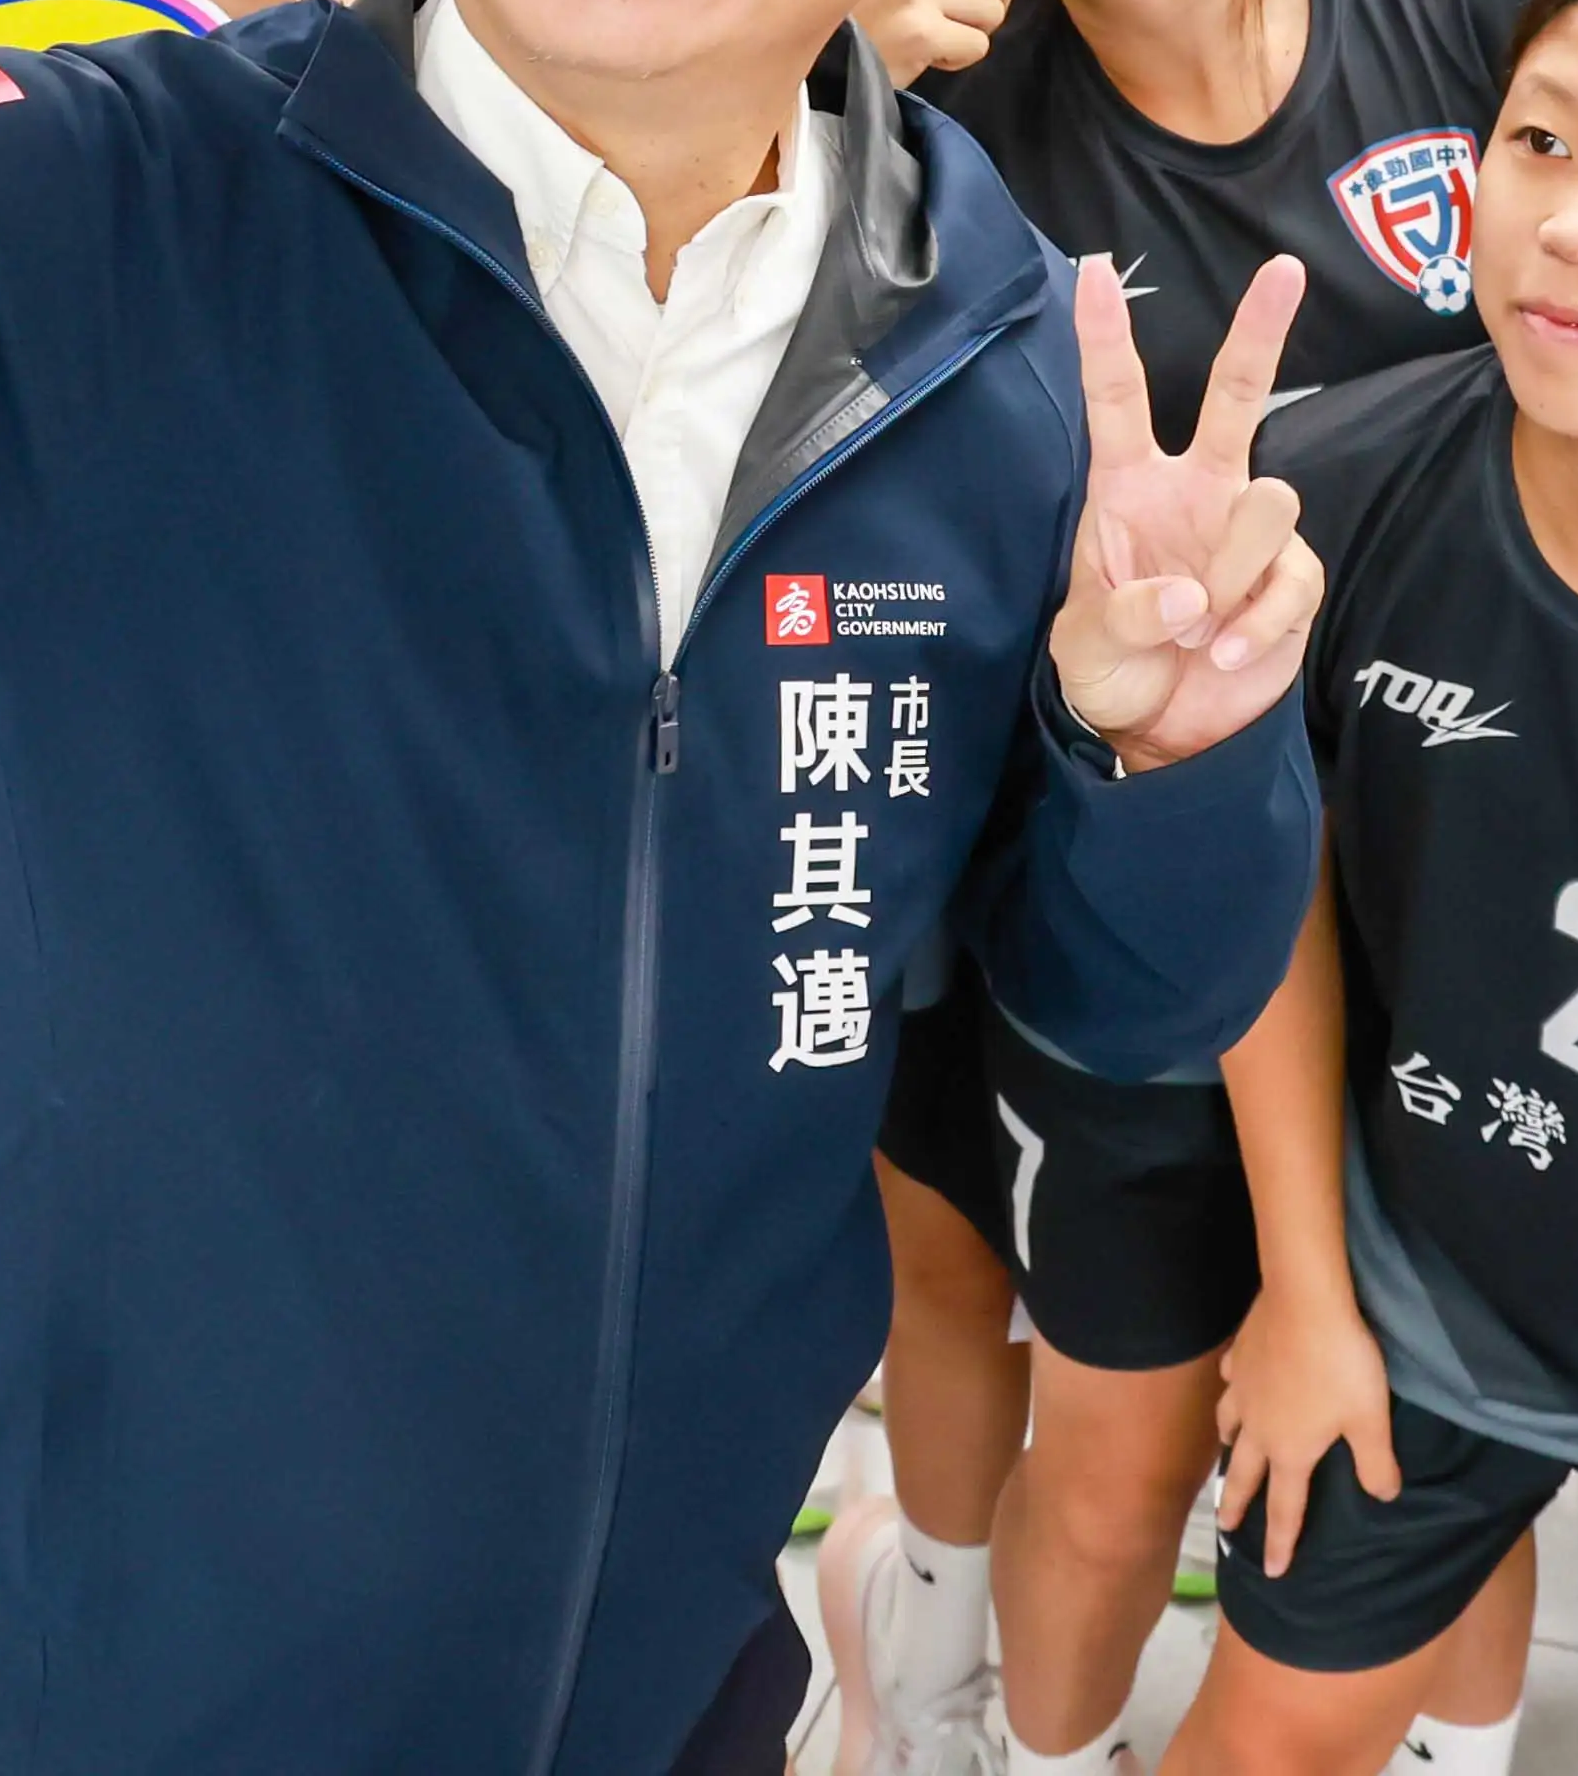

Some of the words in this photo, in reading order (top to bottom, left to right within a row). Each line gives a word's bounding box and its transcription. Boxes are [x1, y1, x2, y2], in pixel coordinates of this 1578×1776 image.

[832, 582, 946, 601] KAOHSIUNG
[834, 603, 876, 617] CITY
[836, 620, 947, 636] GOVERNMENT
[883, 674, 931, 799] 市長
[767, 672, 873, 1074] 陳其邁
